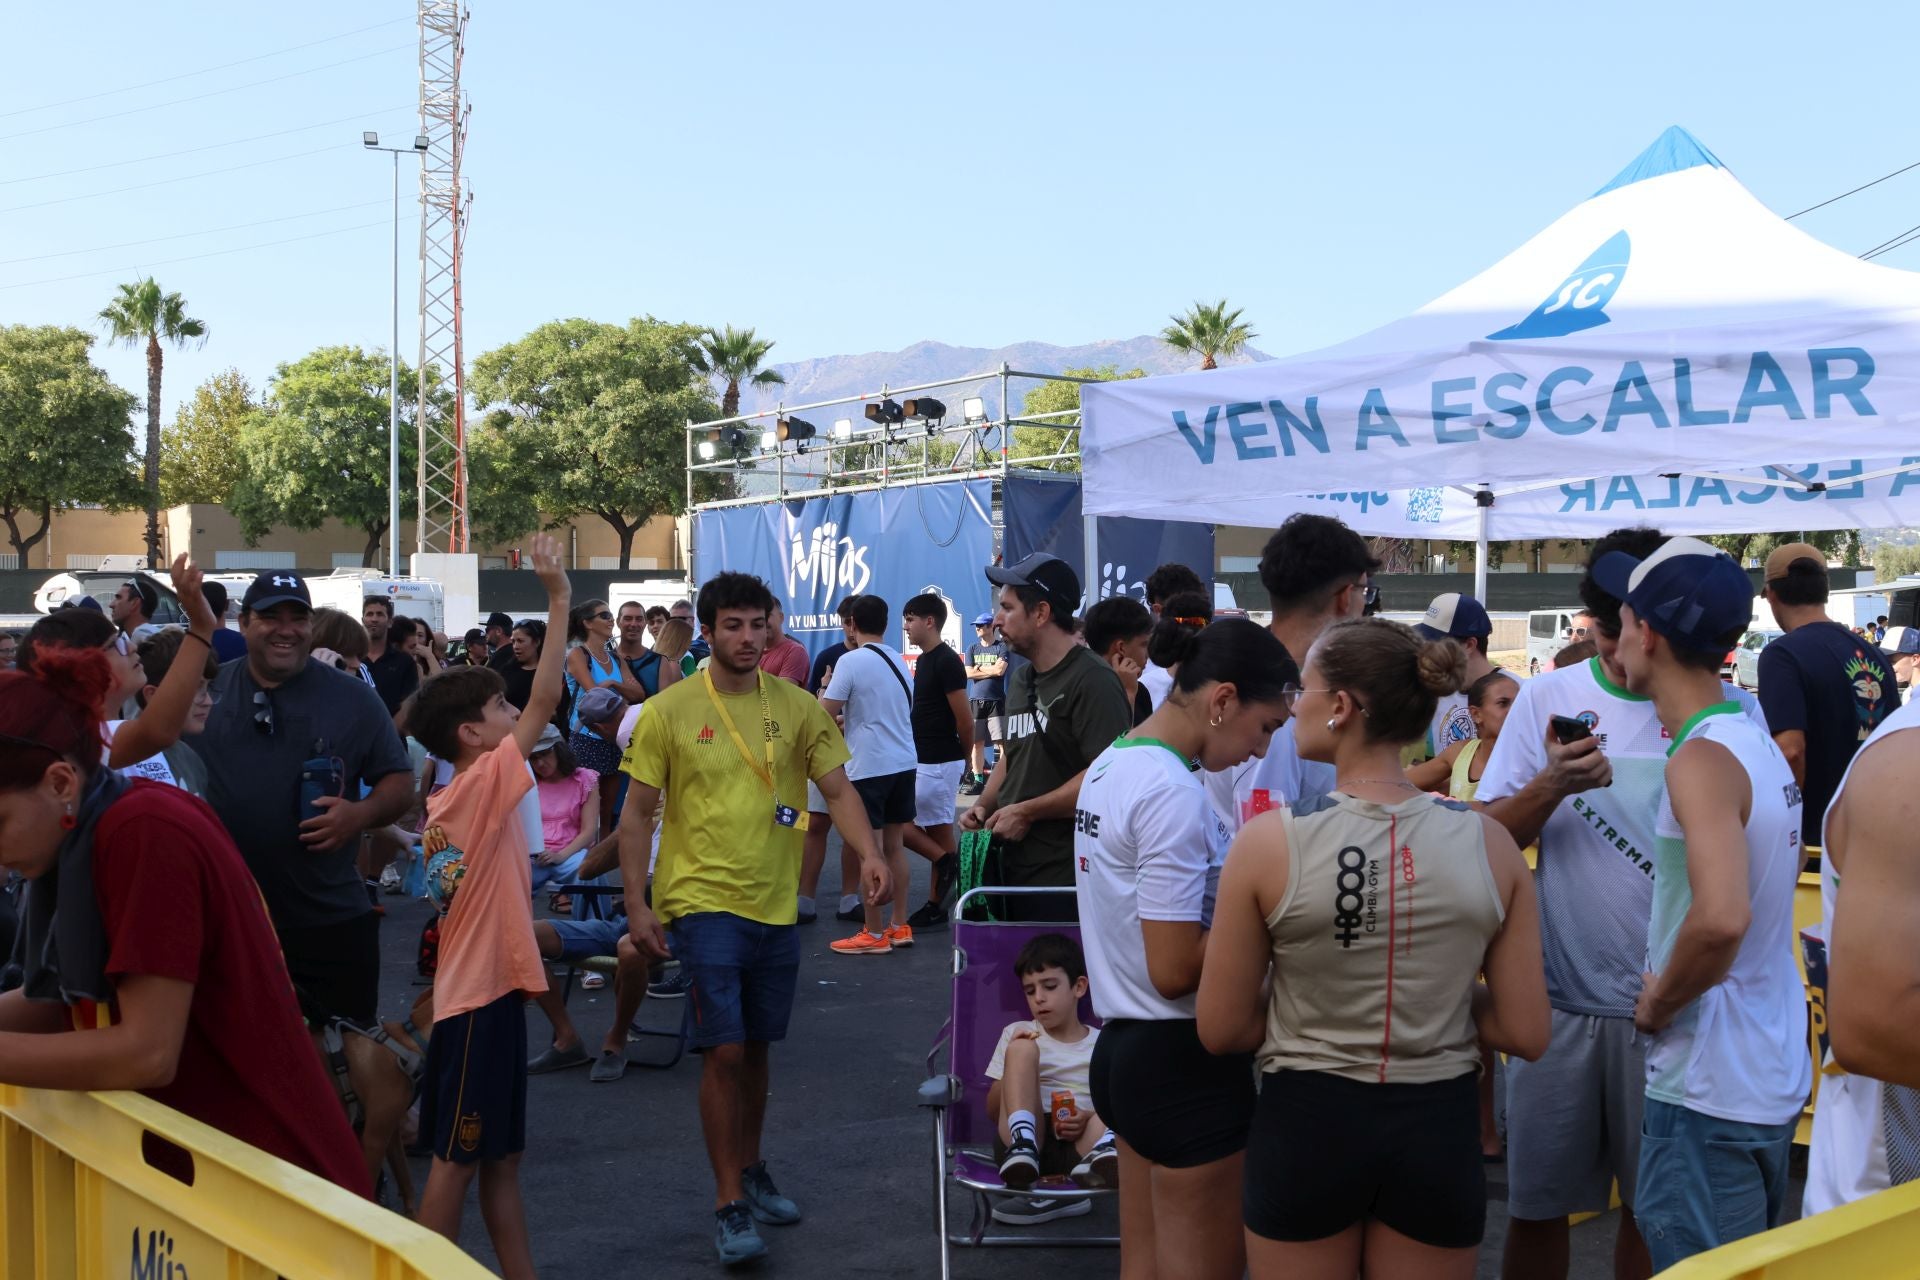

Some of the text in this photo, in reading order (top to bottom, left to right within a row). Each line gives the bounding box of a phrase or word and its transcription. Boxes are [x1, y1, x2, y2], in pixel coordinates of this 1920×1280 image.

[1543, 272, 1616, 315] SC
[1172, 346, 1878, 465] VEN A ESCALAR
[789, 521, 871, 611] Mijas
[1572, 797, 1655, 881] EXTREMA
